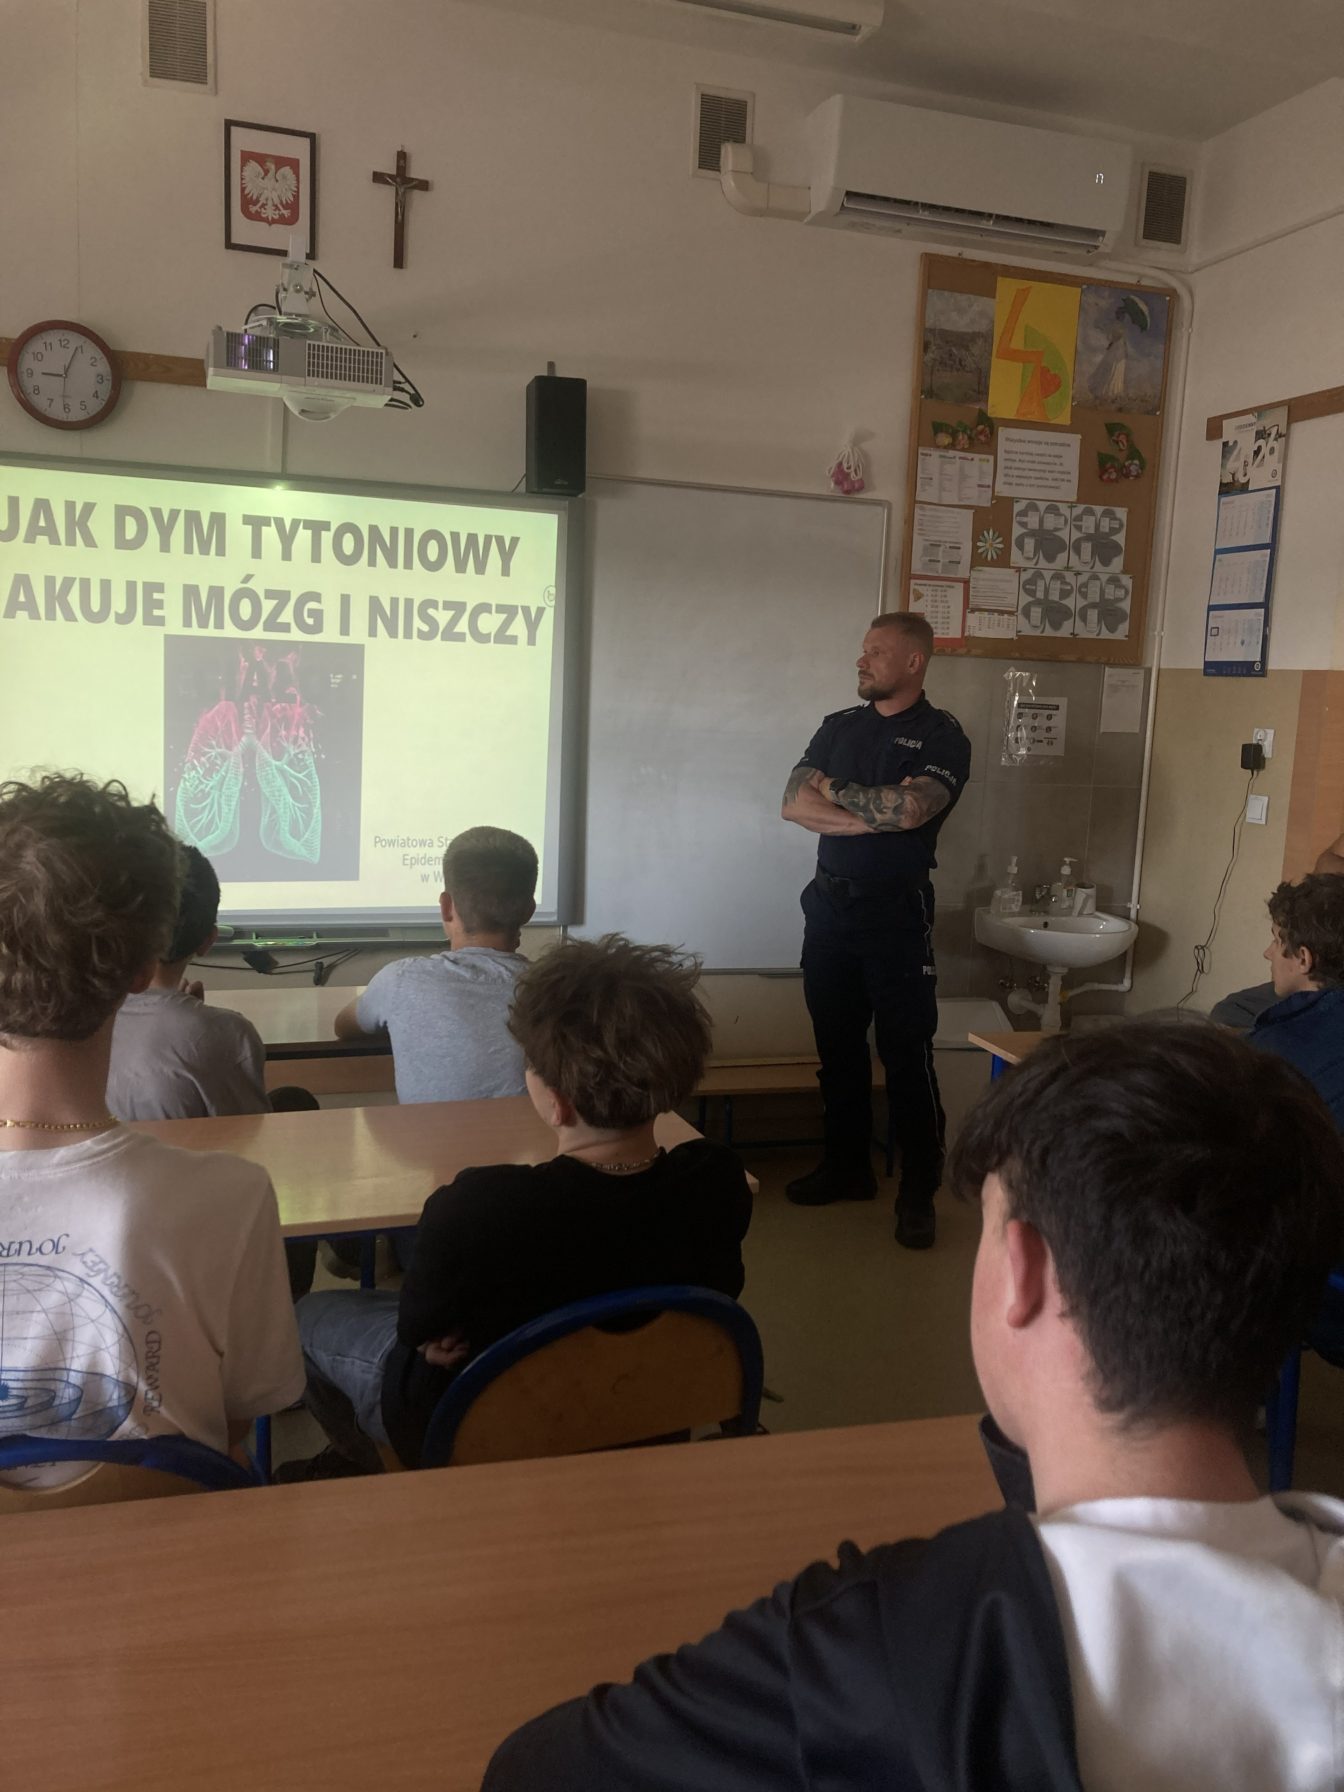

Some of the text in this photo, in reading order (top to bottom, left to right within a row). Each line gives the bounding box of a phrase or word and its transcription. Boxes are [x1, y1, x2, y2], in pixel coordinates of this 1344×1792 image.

[44, 342, 53, 350] 11
[58, 338, 70, 349] 12
[79, 345, 83, 354] 1
[32, 352, 43, 362] 10
[90, 357, 97, 366] 2
[26, 368, 33, 377] 9
[97, 374, 104, 384] 3
[33, 385, 40, 395] 8
[93, 390, 99, 400] 4
[47, 398, 54, 408] 7
[63, 403, 71, 413] 6
[80, 401, 87, 410] 5
[0, 495, 520, 577] JAK DYM TYTONIOWY
[2, 572, 546, 647] AKUJE MÓZG I NISZCZY
[374, 835, 433, 848] Powiatowa
[420, 874, 430, 882] w
